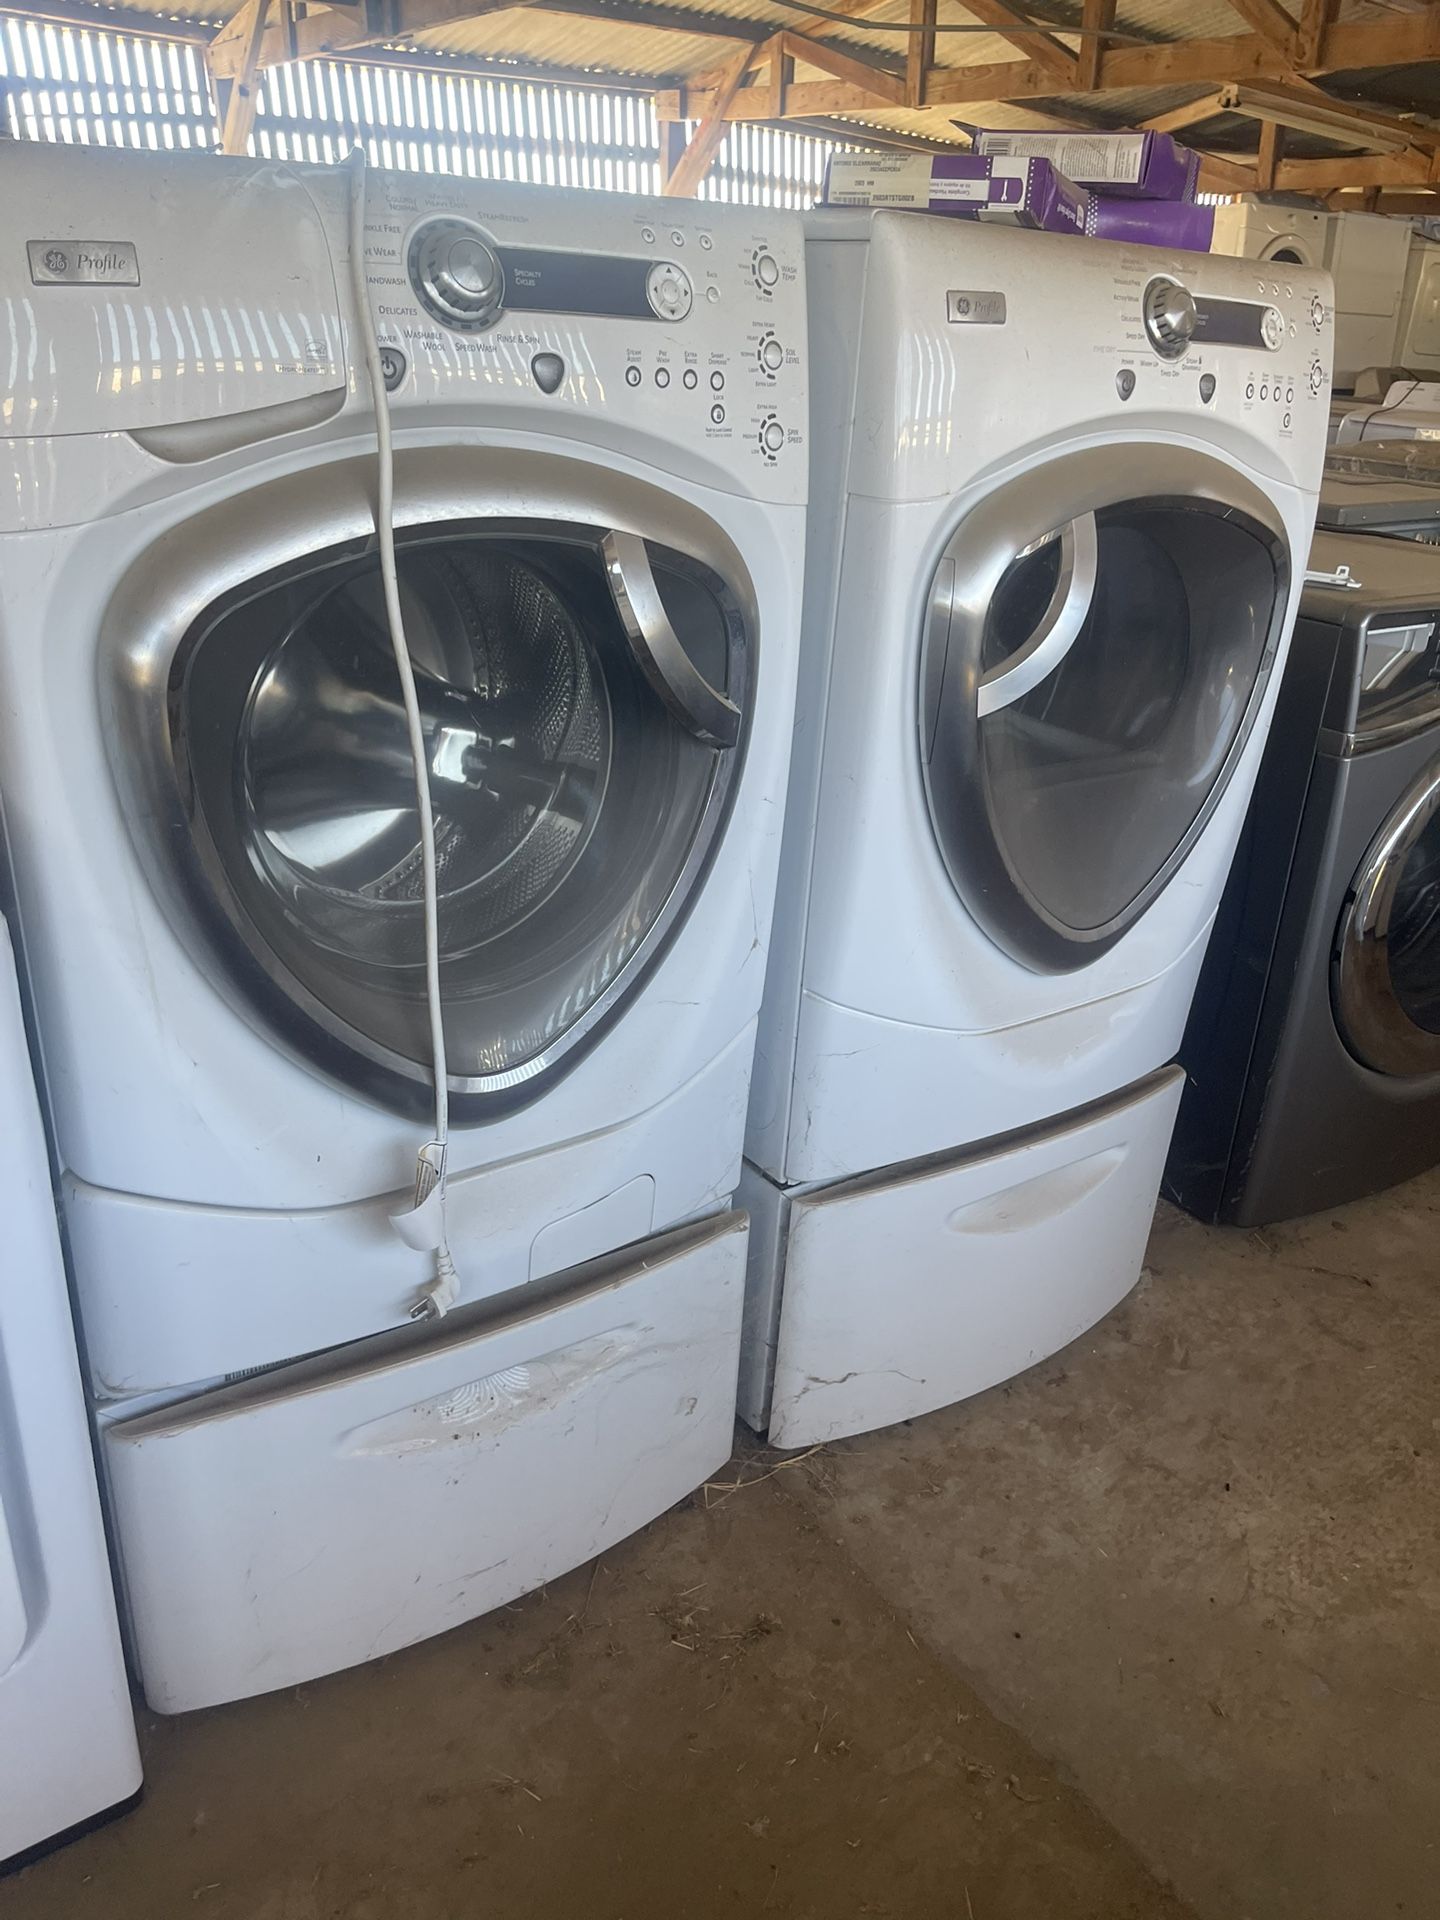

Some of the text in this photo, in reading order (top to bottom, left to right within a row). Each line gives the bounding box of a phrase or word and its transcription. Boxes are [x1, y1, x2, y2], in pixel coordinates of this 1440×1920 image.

[373, 247, 397, 257] WEAR
[77, 253, 126, 275] Profile
[378, 305, 418, 316] DELICATES
[404, 330, 443, 340] WASHABLE
[497, 334, 540, 344] RINSE & SPIN
[423, 341, 446, 351] WOOL
[455, 342, 498, 353] SPEED WASH
[785, 348, 796, 356] SOIL
[785, 356, 800, 364] LEVEL
[787, 428, 799, 436] SPIN
[787, 436, 803, 444] SPEED
